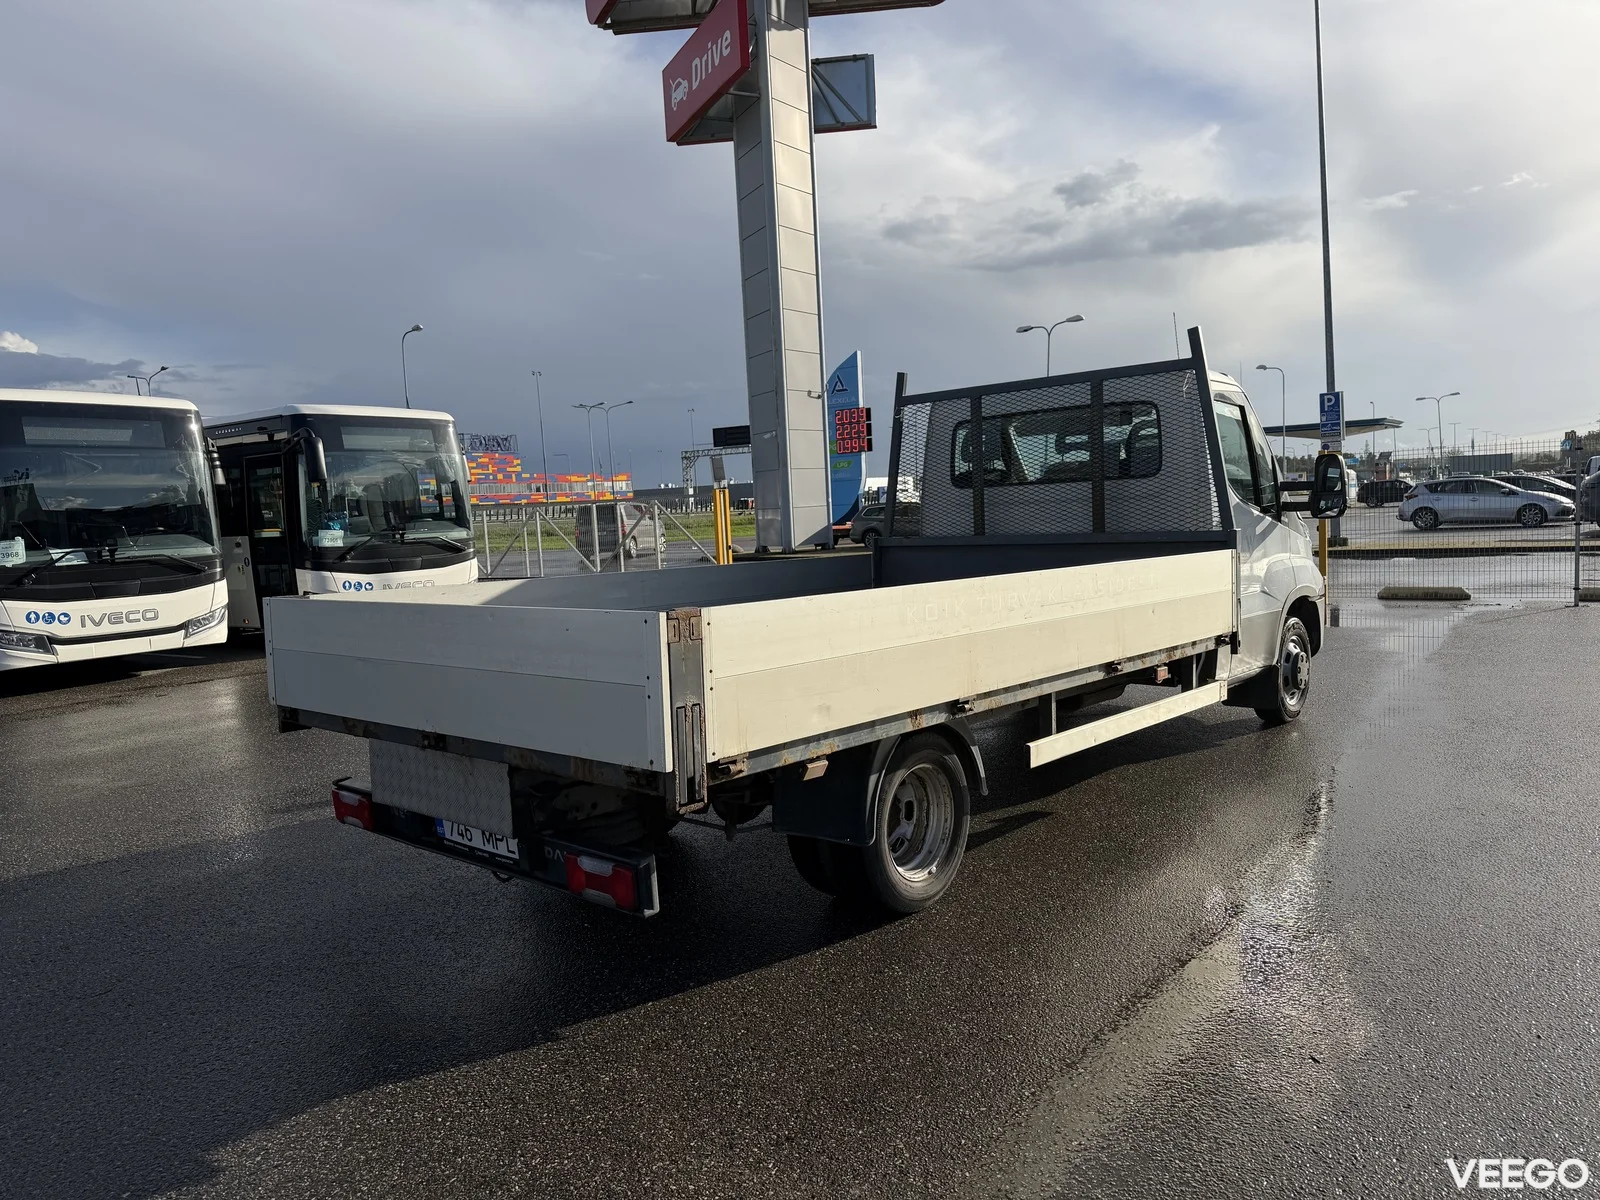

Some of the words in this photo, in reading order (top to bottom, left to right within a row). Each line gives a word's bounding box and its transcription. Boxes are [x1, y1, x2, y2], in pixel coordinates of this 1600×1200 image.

[692, 30, 731, 90] Drive
[1324, 395, 1335, 411] P
[835, 408, 867, 424] 2.039
[836, 423, 867, 439] 2.229
[837, 438, 868, 454] 0.994
[0, 551, 20, 559] 3968
[382, 579, 435, 590] IVECO
[80, 608, 159, 628] IVECO
[480, 830, 516, 854] MPL
